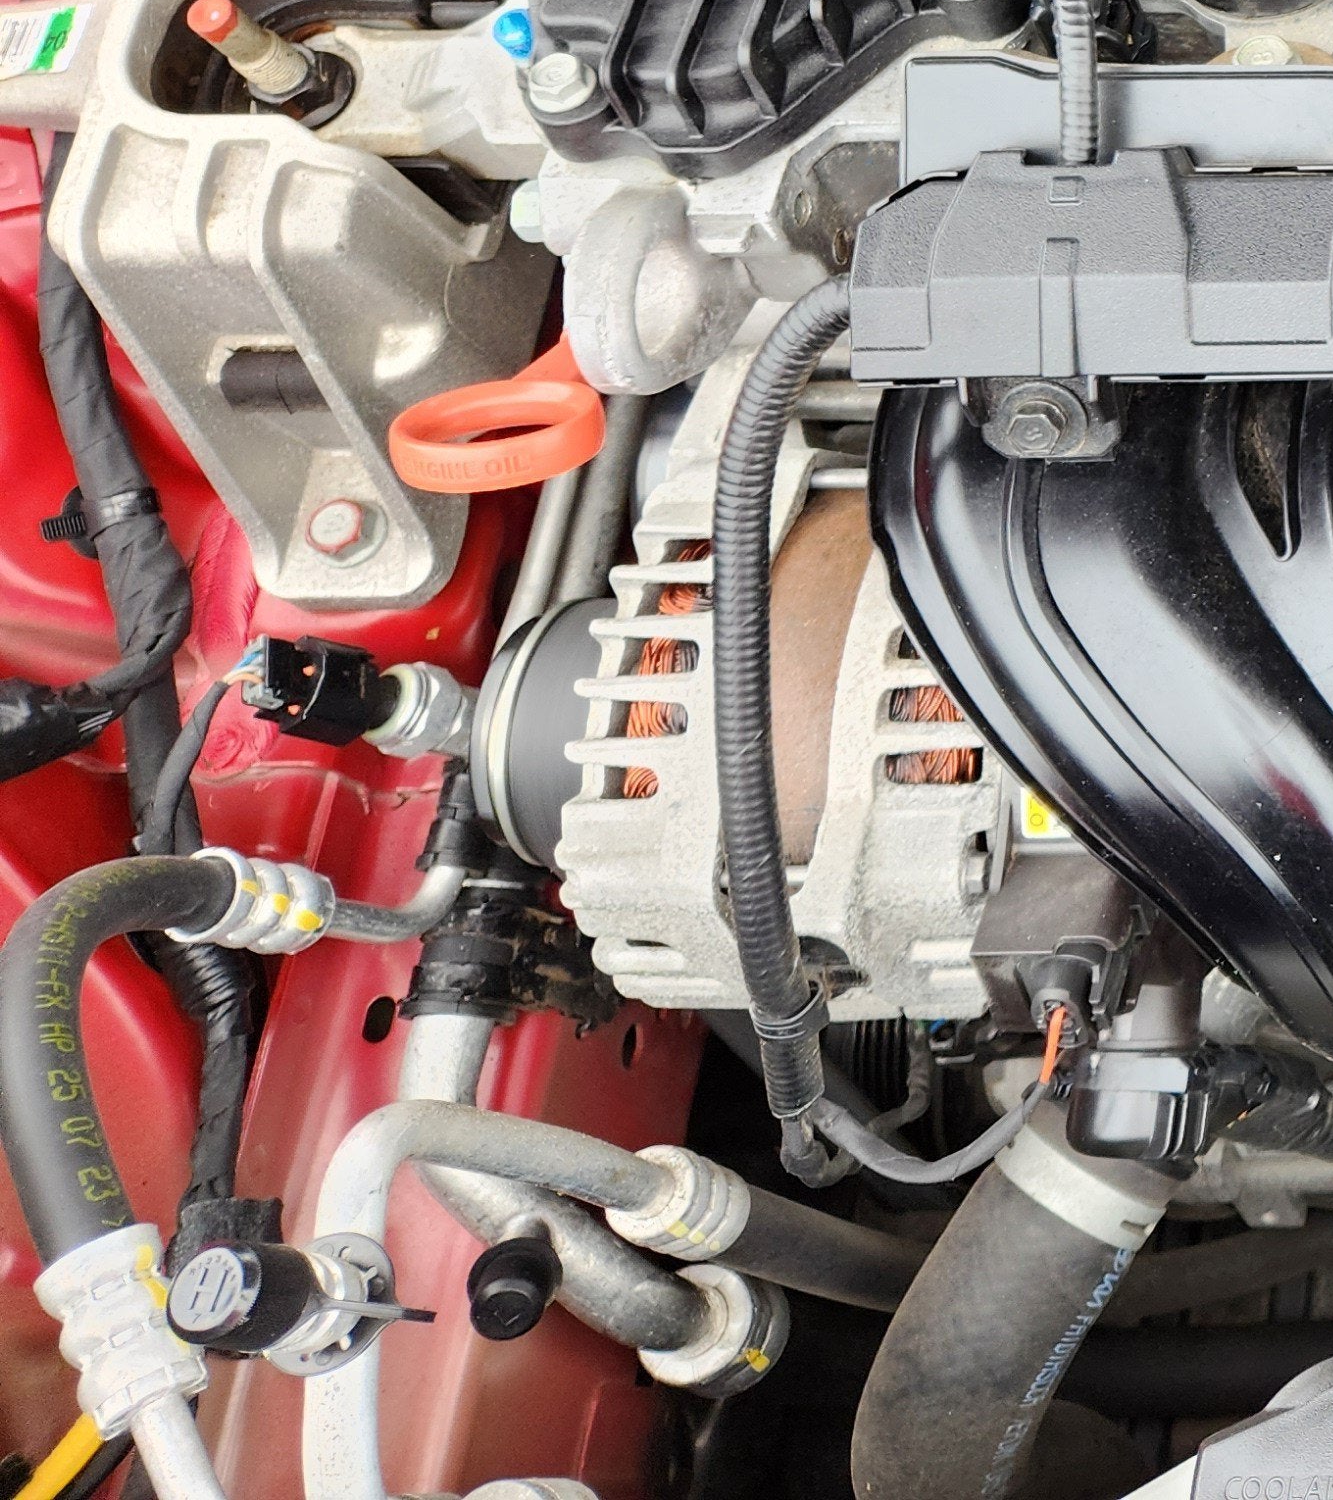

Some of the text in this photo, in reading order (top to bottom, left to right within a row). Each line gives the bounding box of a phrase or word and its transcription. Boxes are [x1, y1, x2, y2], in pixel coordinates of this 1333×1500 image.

[485, 454, 531, 478] OIL
[38, 1022, 76, 1052] HP
[47, 1068, 87, 1102] 25
[59, 1115, 103, 1147] 07
[76, 1164, 121, 1203] 23
